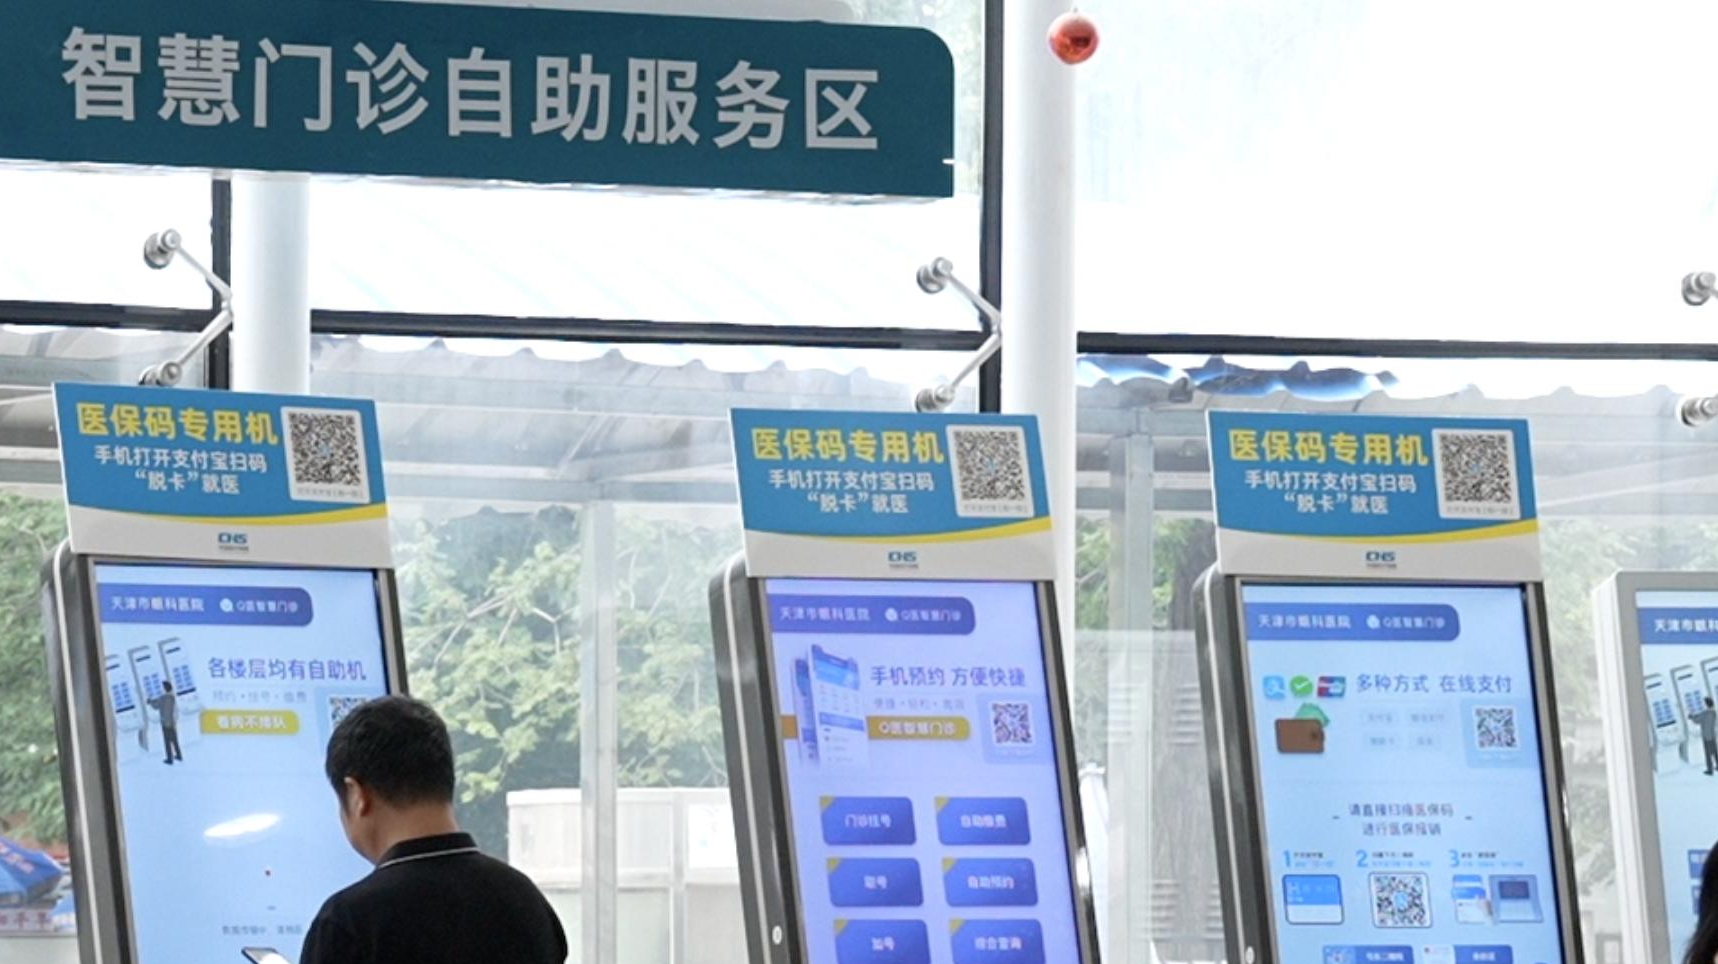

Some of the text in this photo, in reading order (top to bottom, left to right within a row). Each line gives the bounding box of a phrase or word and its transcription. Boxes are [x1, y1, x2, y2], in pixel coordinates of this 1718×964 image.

[61, 26, 879, 152] 智慧门诊自助服务区
[77, 402, 278, 445] 医保码专用机
[751, 428, 944, 463] 医保码专用机
[1229, 429, 1429, 466] 医保码专用机
[95, 445, 267, 474] 手机打开支付宝扫码
[769, 469, 934, 491] 手机打开支付宝扫码
[1245, 470, 1416, 493] 手机打开支付宝扫码
[111, 596, 204, 613] 天津市眼科医院
[780, 607, 870, 621] 天津市眼科医院
[1258, 615, 1351, 629] 天津市眼科医院
[208, 657, 367, 681] 各楼层均有自助机
[870, 666, 1027, 687] 手机预约 方便快捷
[1356, 674, 1512, 694] 多种方式 在线支付
[1283, 850, 1292, 867] 1
[1356, 850, 1369, 867] 2
[1449, 850, 1461, 867] 3
